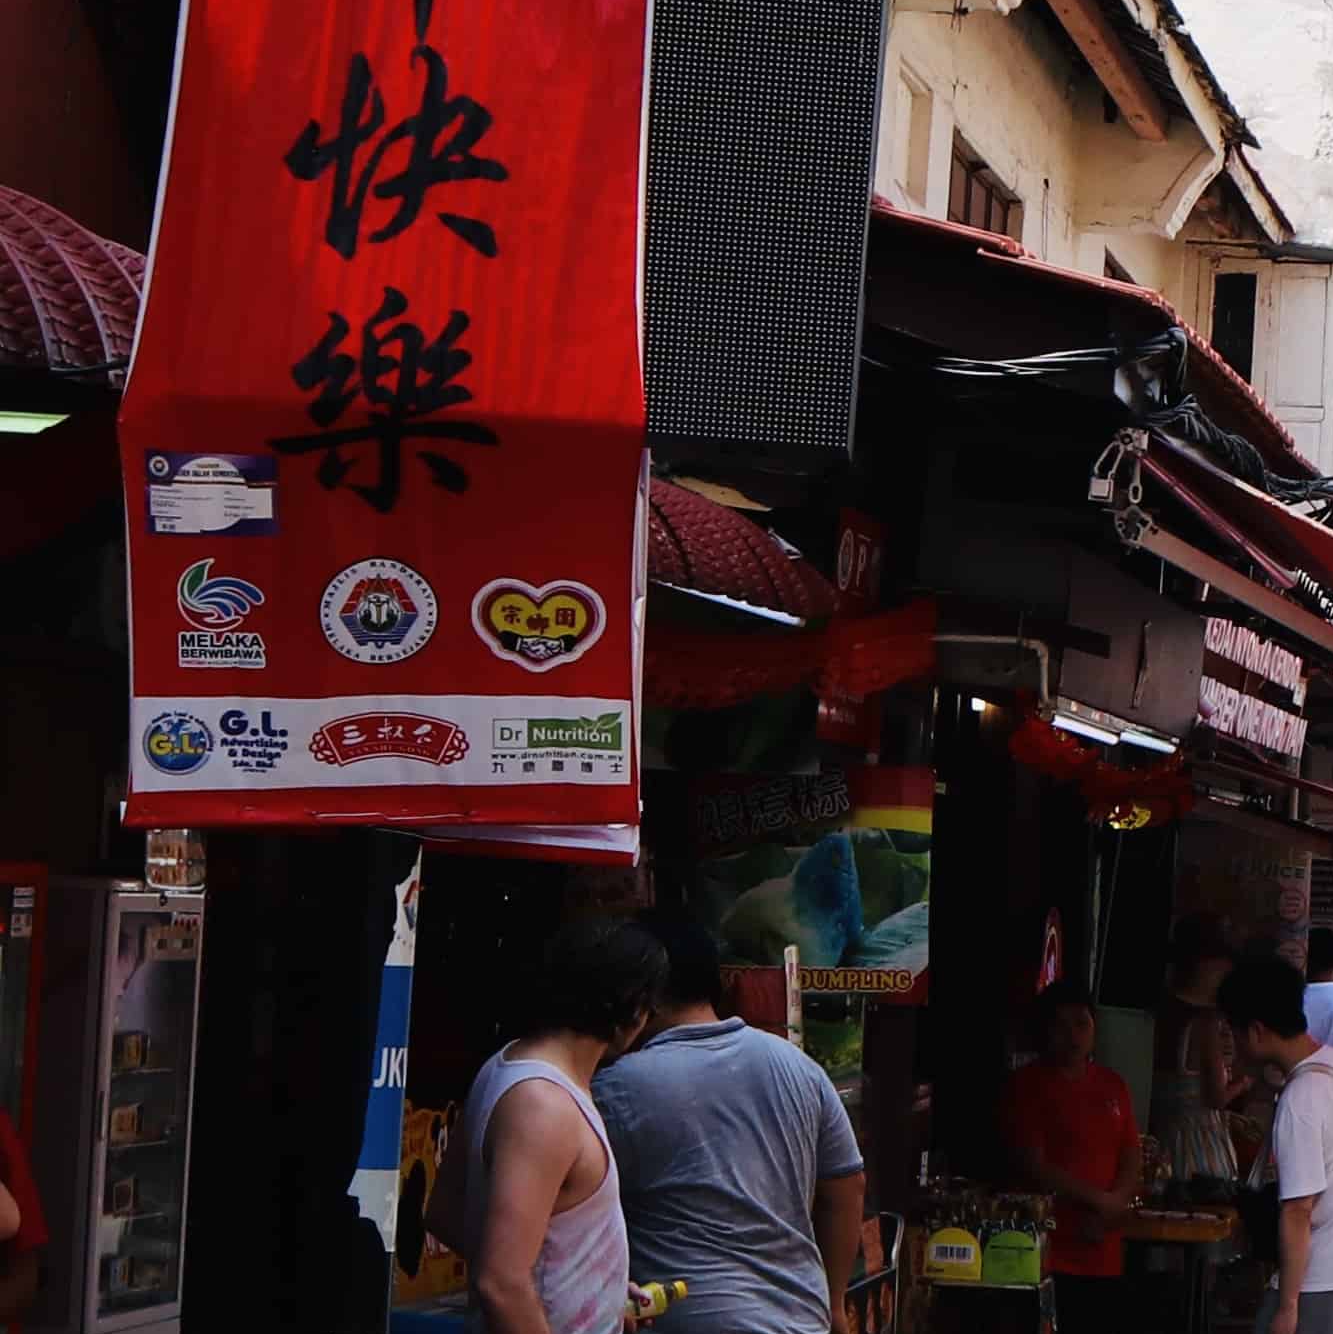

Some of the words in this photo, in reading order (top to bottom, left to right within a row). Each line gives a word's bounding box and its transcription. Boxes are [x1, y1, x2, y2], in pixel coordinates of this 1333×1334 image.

[180, 633, 263, 649] MELAKA
[181, 649, 263, 660] BERWIBAWA
[499, 727, 522, 741] Dr
[532, 727, 612, 743] Nutrition
[220, 738, 288, 751] Advertising
[228, 748, 238, 758] &
[241, 748, 282, 761] Design
[800, 968, 912, 992] DUMPLING
